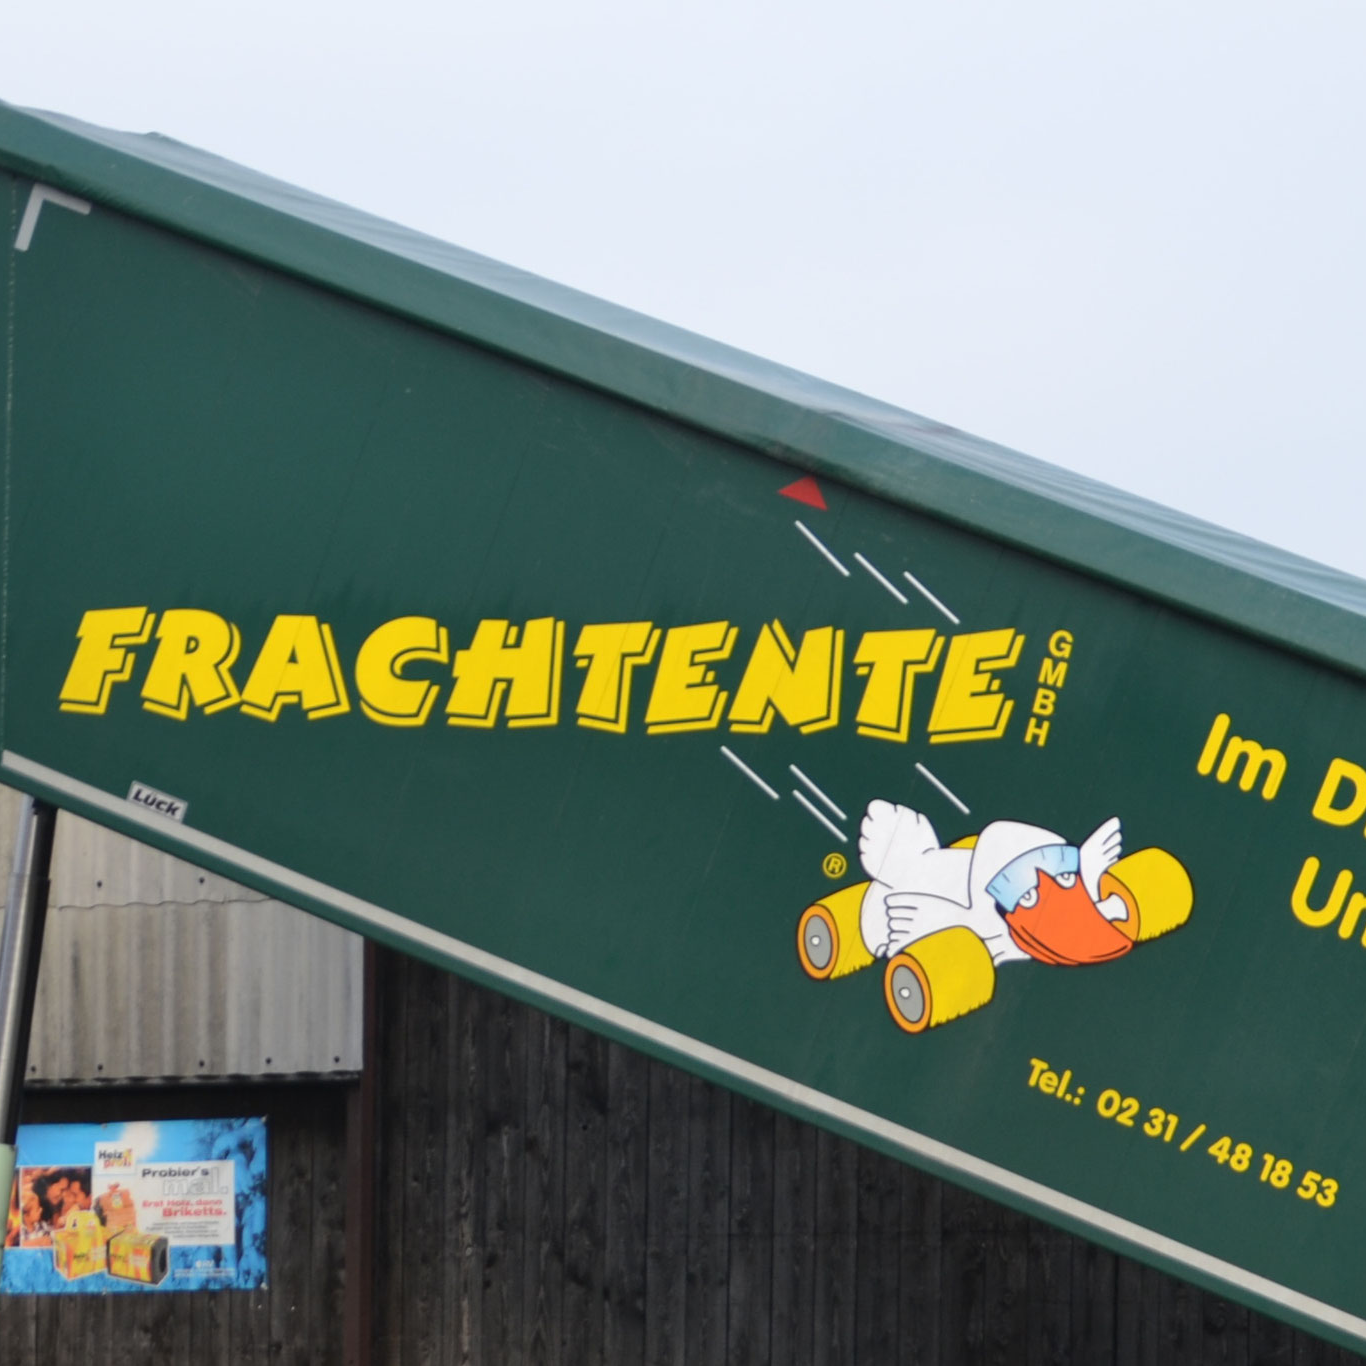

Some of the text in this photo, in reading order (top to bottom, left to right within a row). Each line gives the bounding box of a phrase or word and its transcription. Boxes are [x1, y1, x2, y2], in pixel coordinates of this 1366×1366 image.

[59, 606, 1025, 745] FRACHTENTE
[1196, 712, 1287, 801] Im
[1028, 1057, 1086, 1106] Tel.:
[1096, 1088, 1140, 1127] 02
[1143, 1107, 1179, 1142] 31
[1207, 1135, 1253, 1173] 48
[1259, 1152, 1294, 1189] 18
[1296, 1170, 1339, 1208] 53
